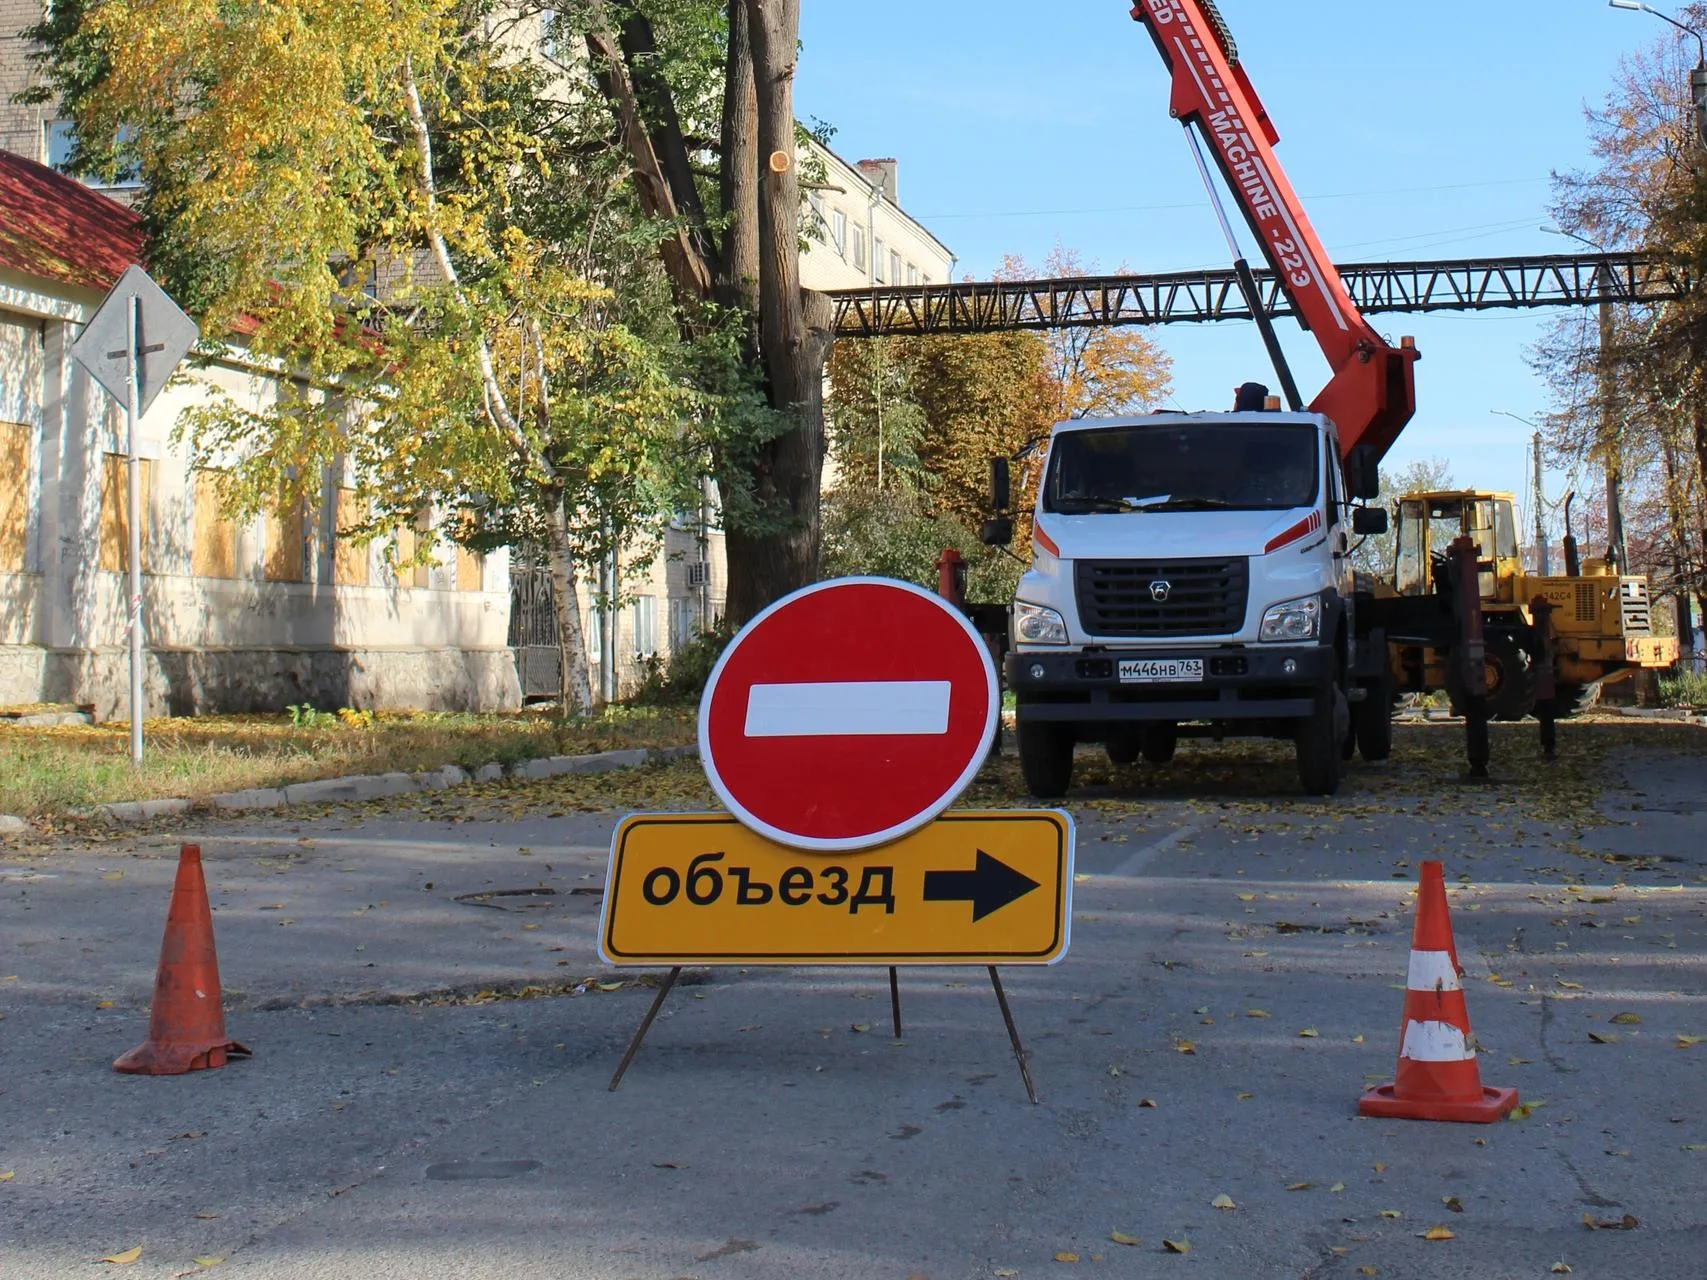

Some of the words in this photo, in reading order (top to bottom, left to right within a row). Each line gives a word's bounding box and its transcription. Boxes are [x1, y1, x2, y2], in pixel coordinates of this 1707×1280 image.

[1208, 110, 1278, 221] MACHINE
[1179, 660, 1200, 672] 763
[642, 851, 896, 914] объезд
